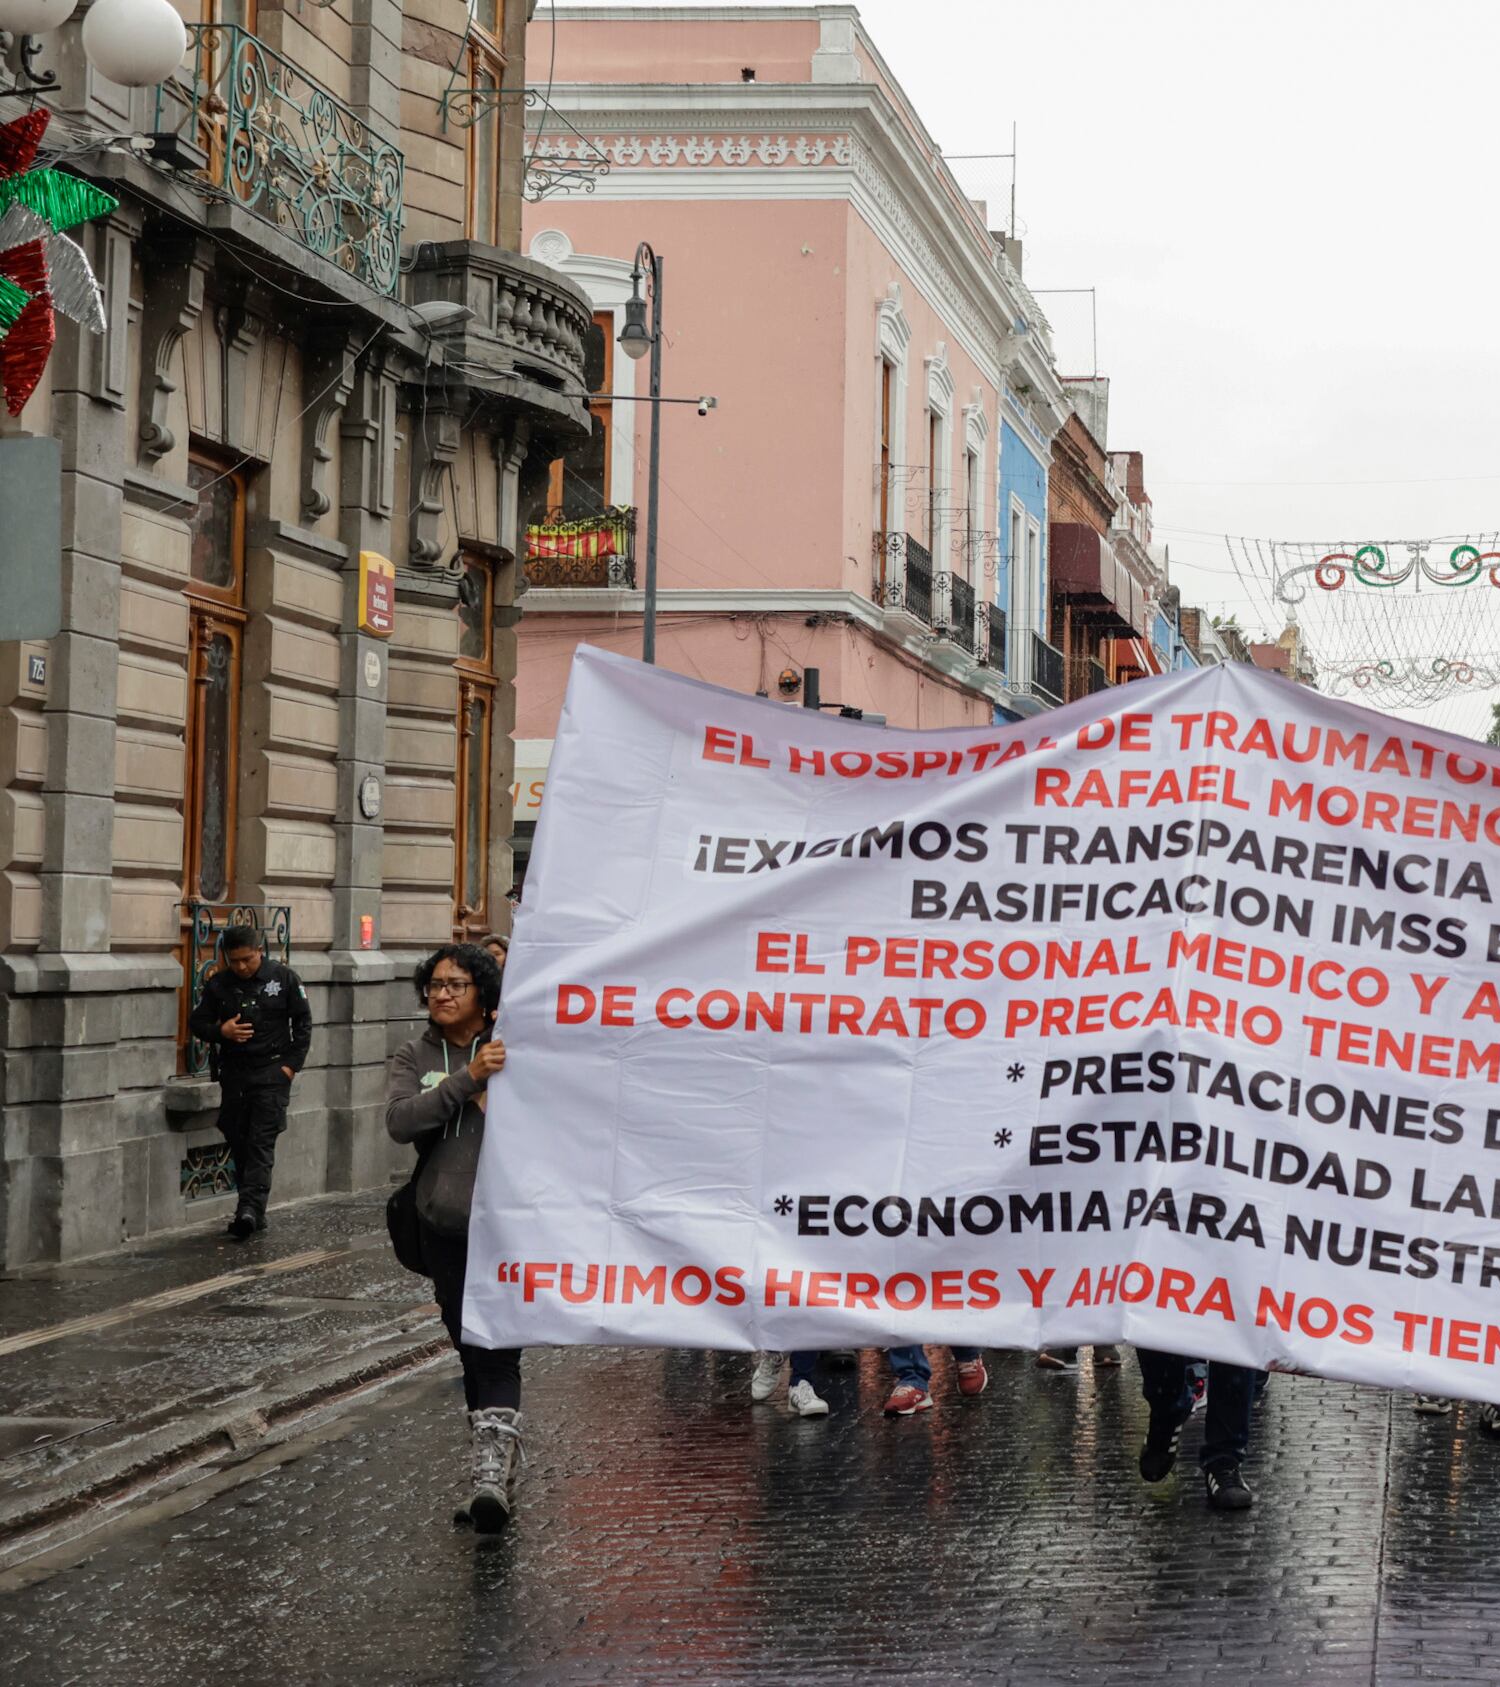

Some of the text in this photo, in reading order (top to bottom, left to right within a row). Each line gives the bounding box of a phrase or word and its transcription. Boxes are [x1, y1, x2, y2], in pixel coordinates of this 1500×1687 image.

[703, 726, 769, 768] EL
[789, 737, 1056, 779] HOSPITAL
[1077, 713, 1152, 752] DE
[1034, 765, 1249, 810] RAFAEL
[1006, 819, 1492, 903] TRANSPARENCIA
[911, 875, 1313, 937] BASIFICACION
[1332, 905, 1466, 958] IMSS
[756, 932, 825, 974] EL
[846, 936, 1151, 981] PERSONAL
[1168, 930, 1389, 1008] MEDICO
[1411, 974, 1448, 1015] Y
[556, 984, 636, 1026] DE
[656, 988, 986, 1039] CONTRATO
[1005, 987, 1282, 1045] PRECARIO
[1041, 1049, 1467, 1144] PRESTACIONES
[1029, 1121, 1391, 1199] ESTABILIDAD
[1123, 1188, 1265, 1248] PARA
[765, 1269, 1001, 1310] HEROES
[1019, 1268, 1055, 1308] Y
[1067, 1262, 1236, 1321] AHORA
[1255, 1287, 1373, 1344] NOS
